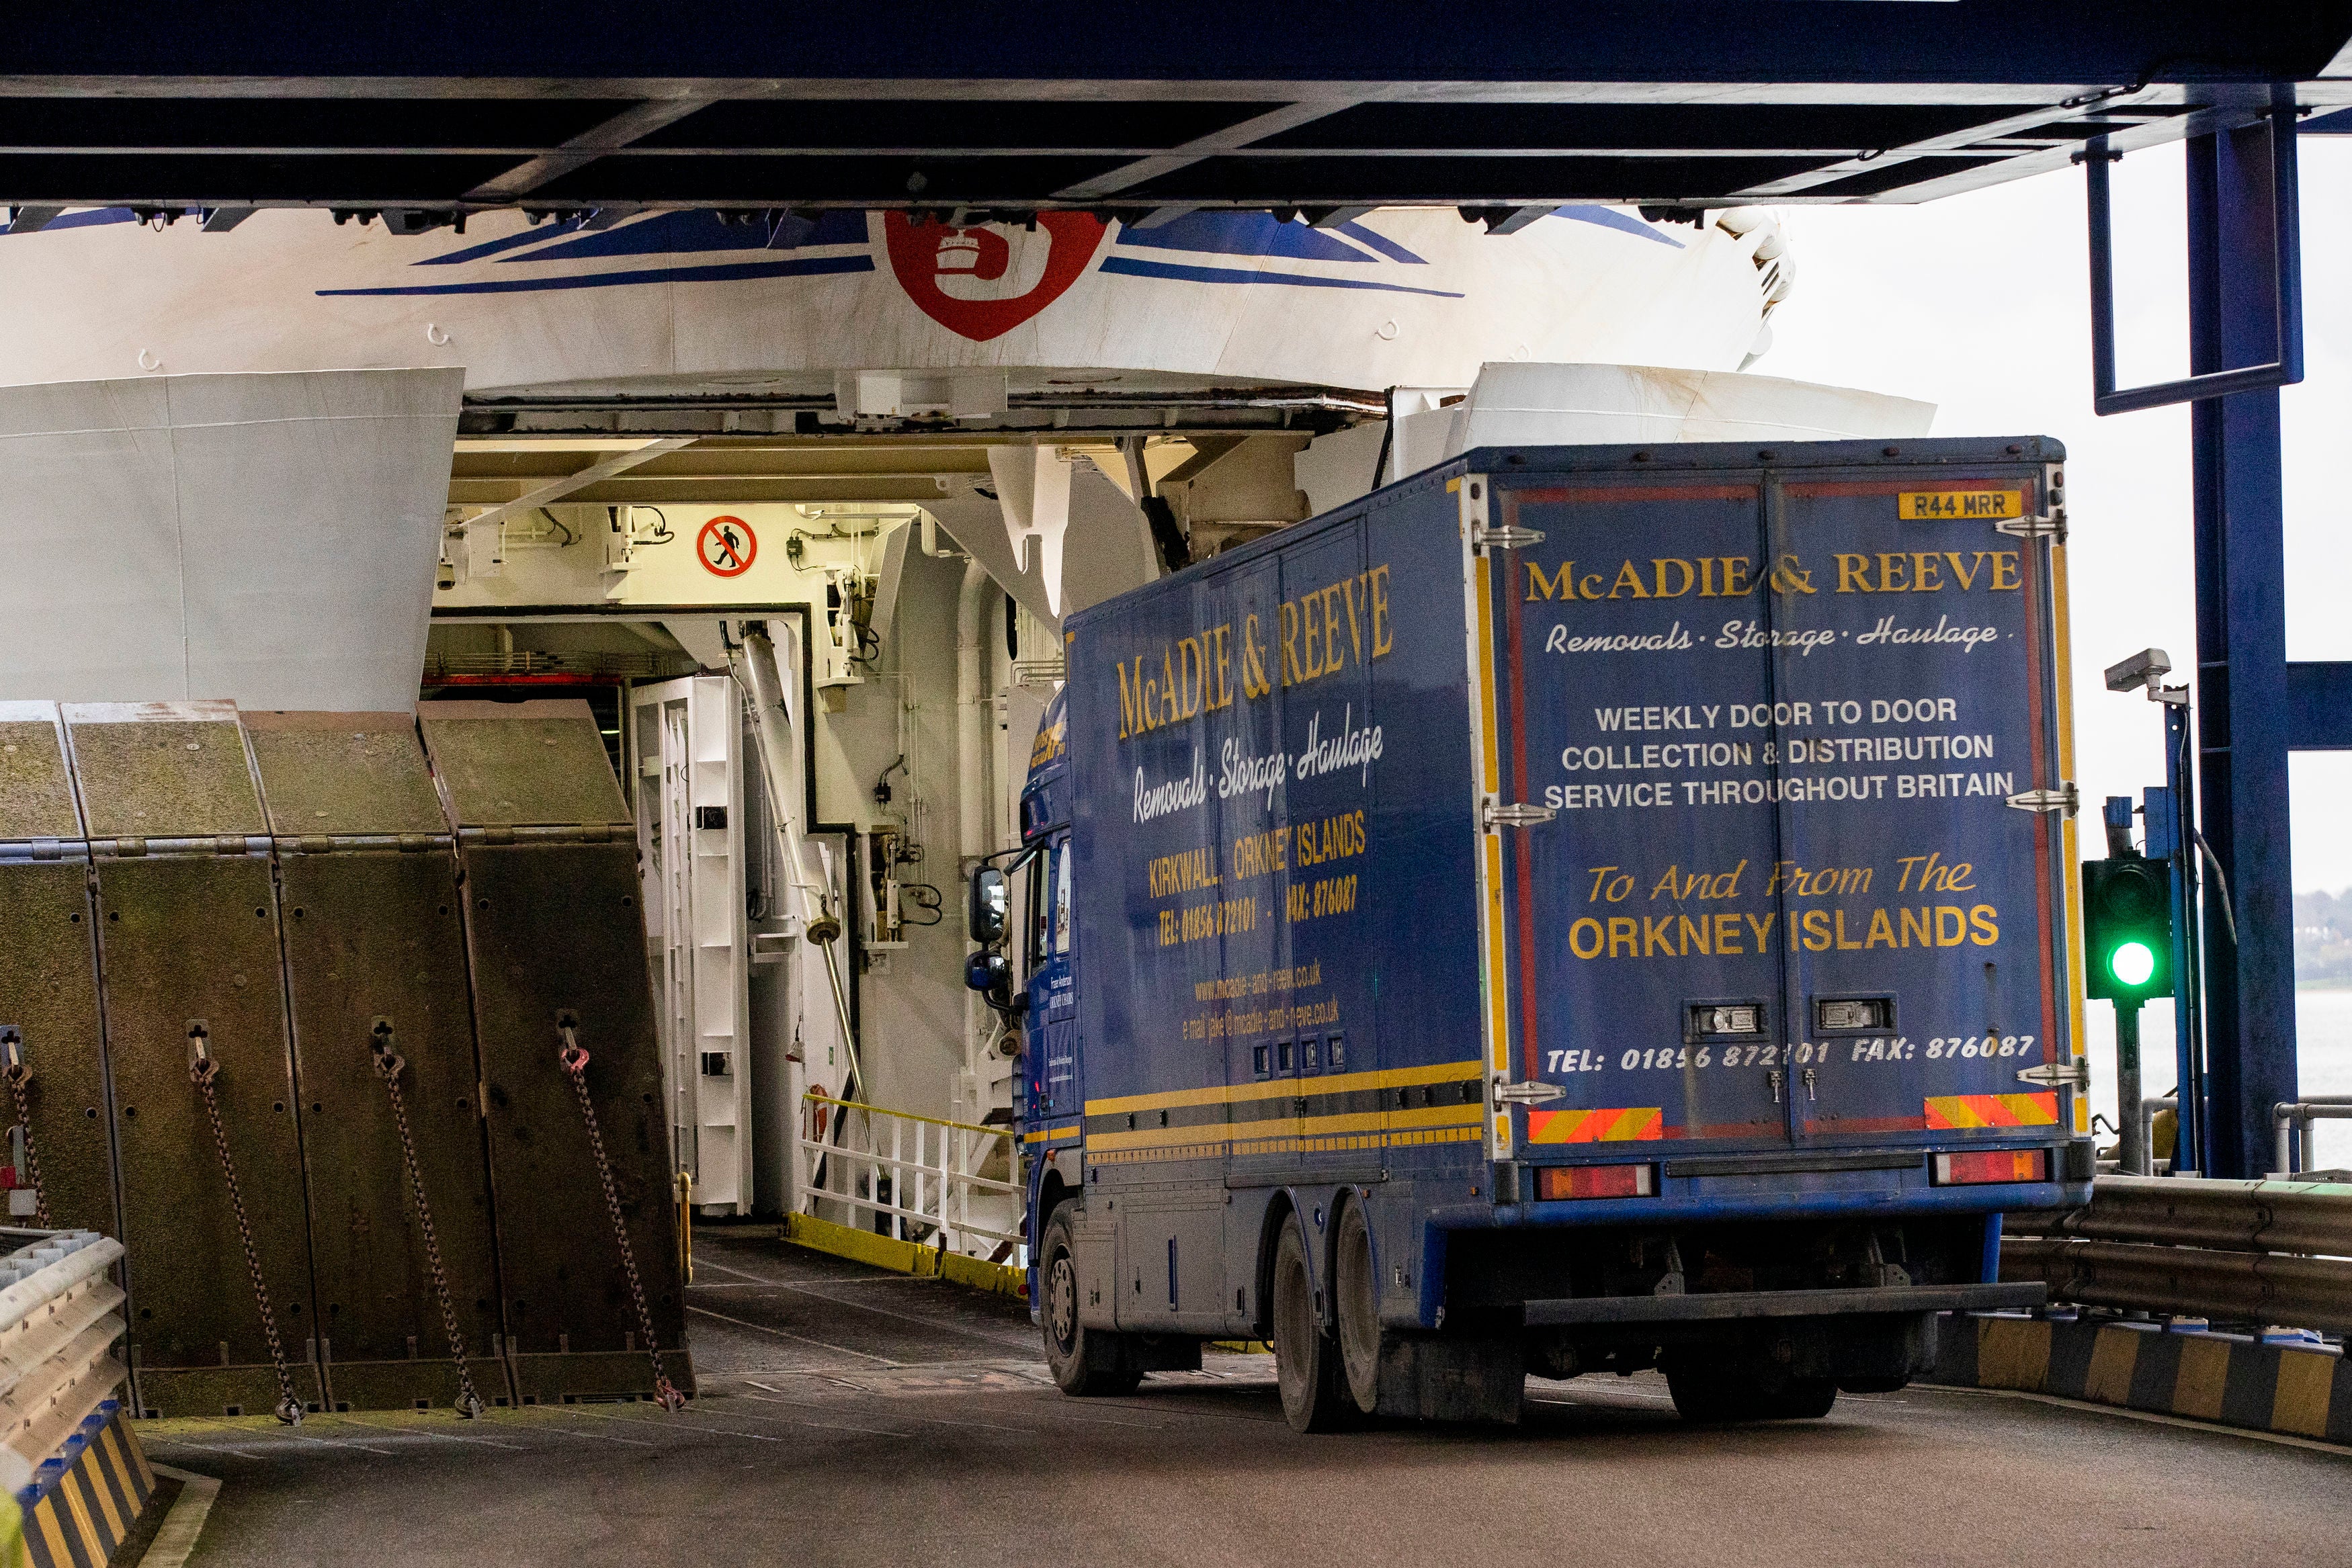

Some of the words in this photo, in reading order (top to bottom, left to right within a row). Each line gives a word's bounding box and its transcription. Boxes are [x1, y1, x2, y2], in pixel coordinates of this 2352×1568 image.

[1915, 495, 1957, 516] R44
[1963, 494, 2006, 515] MRR
[1525, 556, 1753, 602] McADIE
[1770, 554, 1817, 595] &
[1833, 552, 2023, 594] REEVE
[1117, 623, 1234, 740] McADIE
[1243, 614, 1271, 699] &
[1279, 564, 1394, 687] REEVE
[1546, 621, 1692, 654] Removals
[1715, 619, 1837, 657] Storage
[1856, 614, 1999, 658] Haulage
[1595, 704, 1721, 732] WEEKLY
[1730, 701, 1813, 728] DOOR
[1820, 700, 1863, 725] TO
[1871, 697, 1956, 724] DOOR
[1134, 747, 1206, 824] Removals
[1218, 738, 1286, 812] Storage
[1297, 702, 1383, 788] Haulage
[1562, 742, 1753, 772] COLLECTION
[1762, 741, 1780, 765] &
[1788, 736, 1994, 765] DISTRIBUTION
[1544, 782, 1675, 810] SERVICE
[1681, 775, 1890, 805] THROUGHOUT
[1896, 772, 2015, 799] BRITAIN
[1234, 826, 1292, 880] ORKNEY
[1297, 810, 1366, 868] ISLANDS
[1587, 865, 1634, 902] To
[1649, 859, 1749, 901] And
[1765, 860, 1874, 896] From
[1896, 851, 1978, 892] The
[1159, 910, 1179, 947] TEL:
[1181, 904, 1214, 943] 01856
[1216, 896, 1256, 936] 872101
[1313, 874, 1357, 918] 876087
[1569, 912, 1777, 960] ORKNEY
[1790, 904, 2001, 953] ISLANDS
[1547, 1049, 1605, 1073] TEL:
[1620, 1046, 1711, 1071] 01856
[1722, 1041, 1830, 1068] 872101
[1851, 1036, 1915, 1061] FAX:
[1925, 1035, 2035, 1059] 876087
